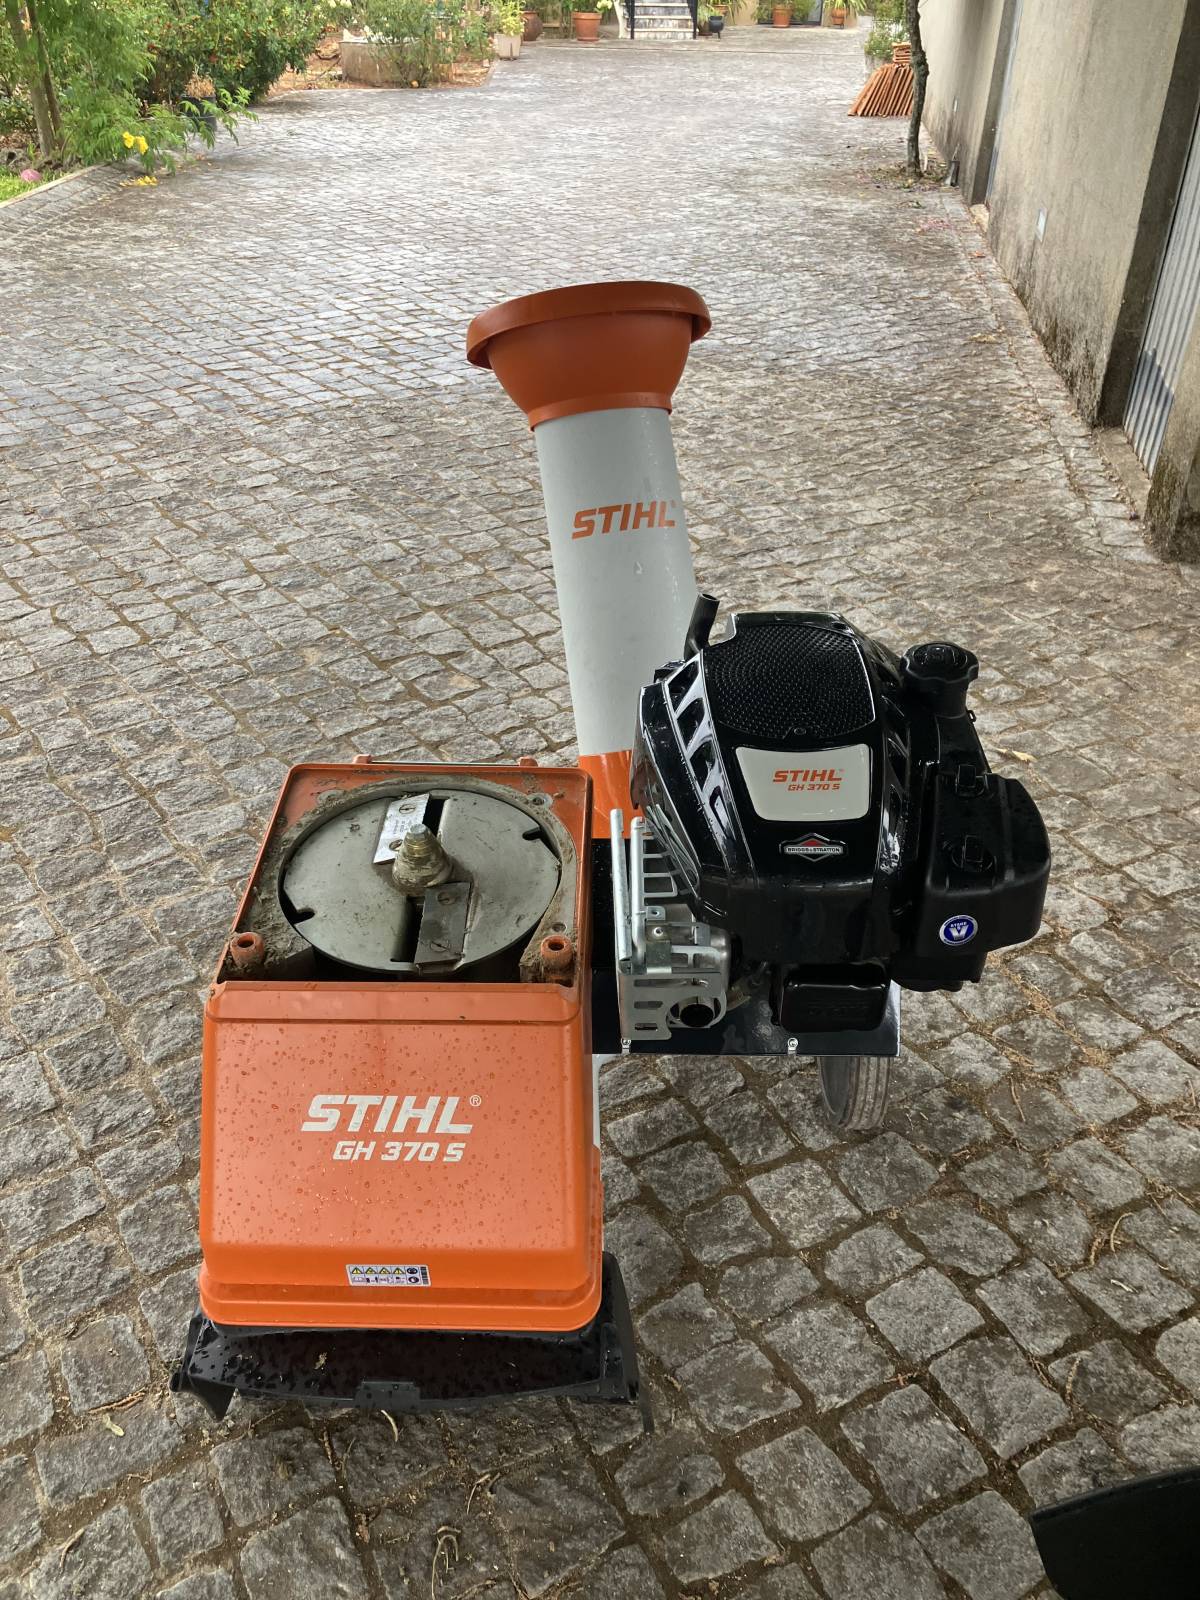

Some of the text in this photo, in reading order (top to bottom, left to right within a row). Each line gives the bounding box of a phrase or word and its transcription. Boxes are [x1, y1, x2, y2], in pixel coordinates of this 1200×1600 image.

[571, 500, 676, 540] STIHL
[772, 769, 843, 783] STIHL
[806, 783, 830, 791] 370
[332, 1140, 467, 1162] GH 370 S
